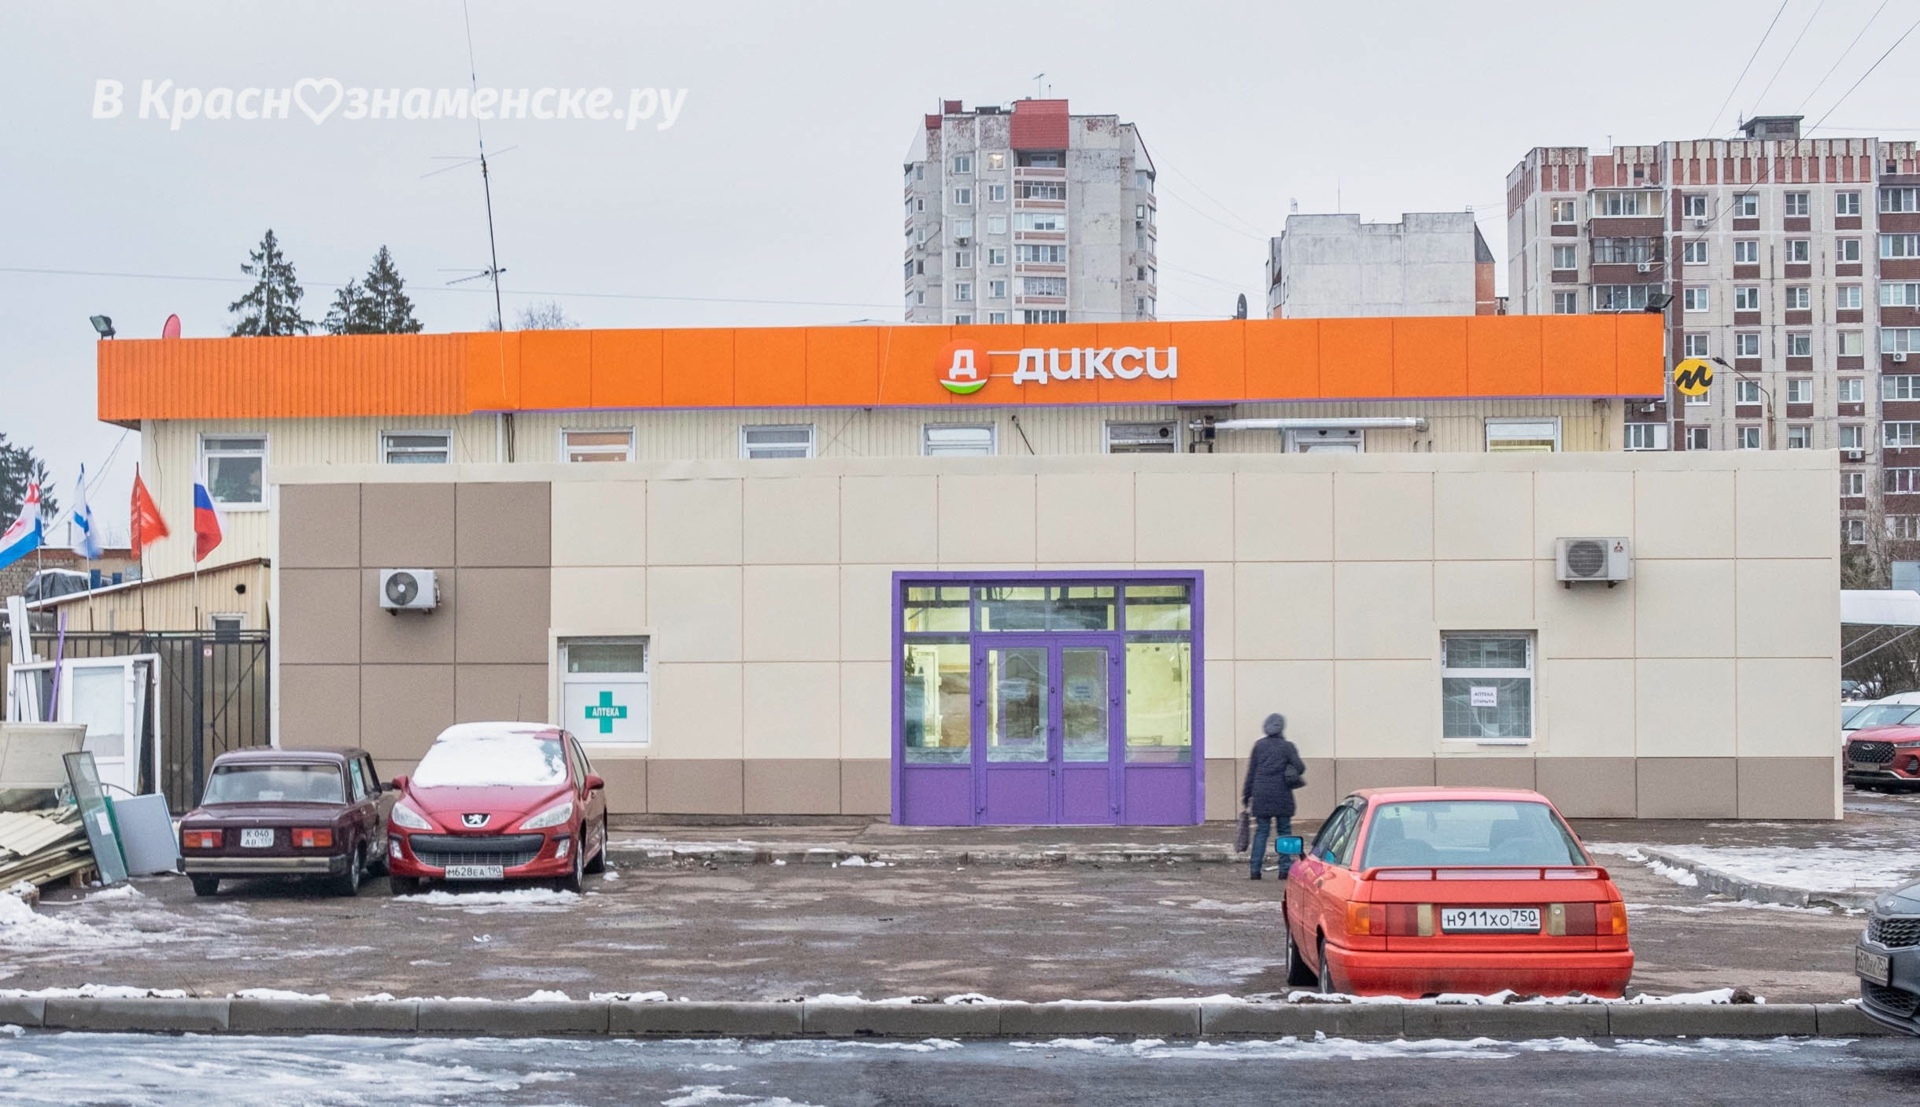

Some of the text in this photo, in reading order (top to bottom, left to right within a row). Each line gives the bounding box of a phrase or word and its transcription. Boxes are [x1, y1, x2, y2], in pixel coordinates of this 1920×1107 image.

[949, 349, 977, 379] Д
[592, 707, 619, 717] АПТЕКА
[1447, 910, 1536, 926] Н911ХО 750
